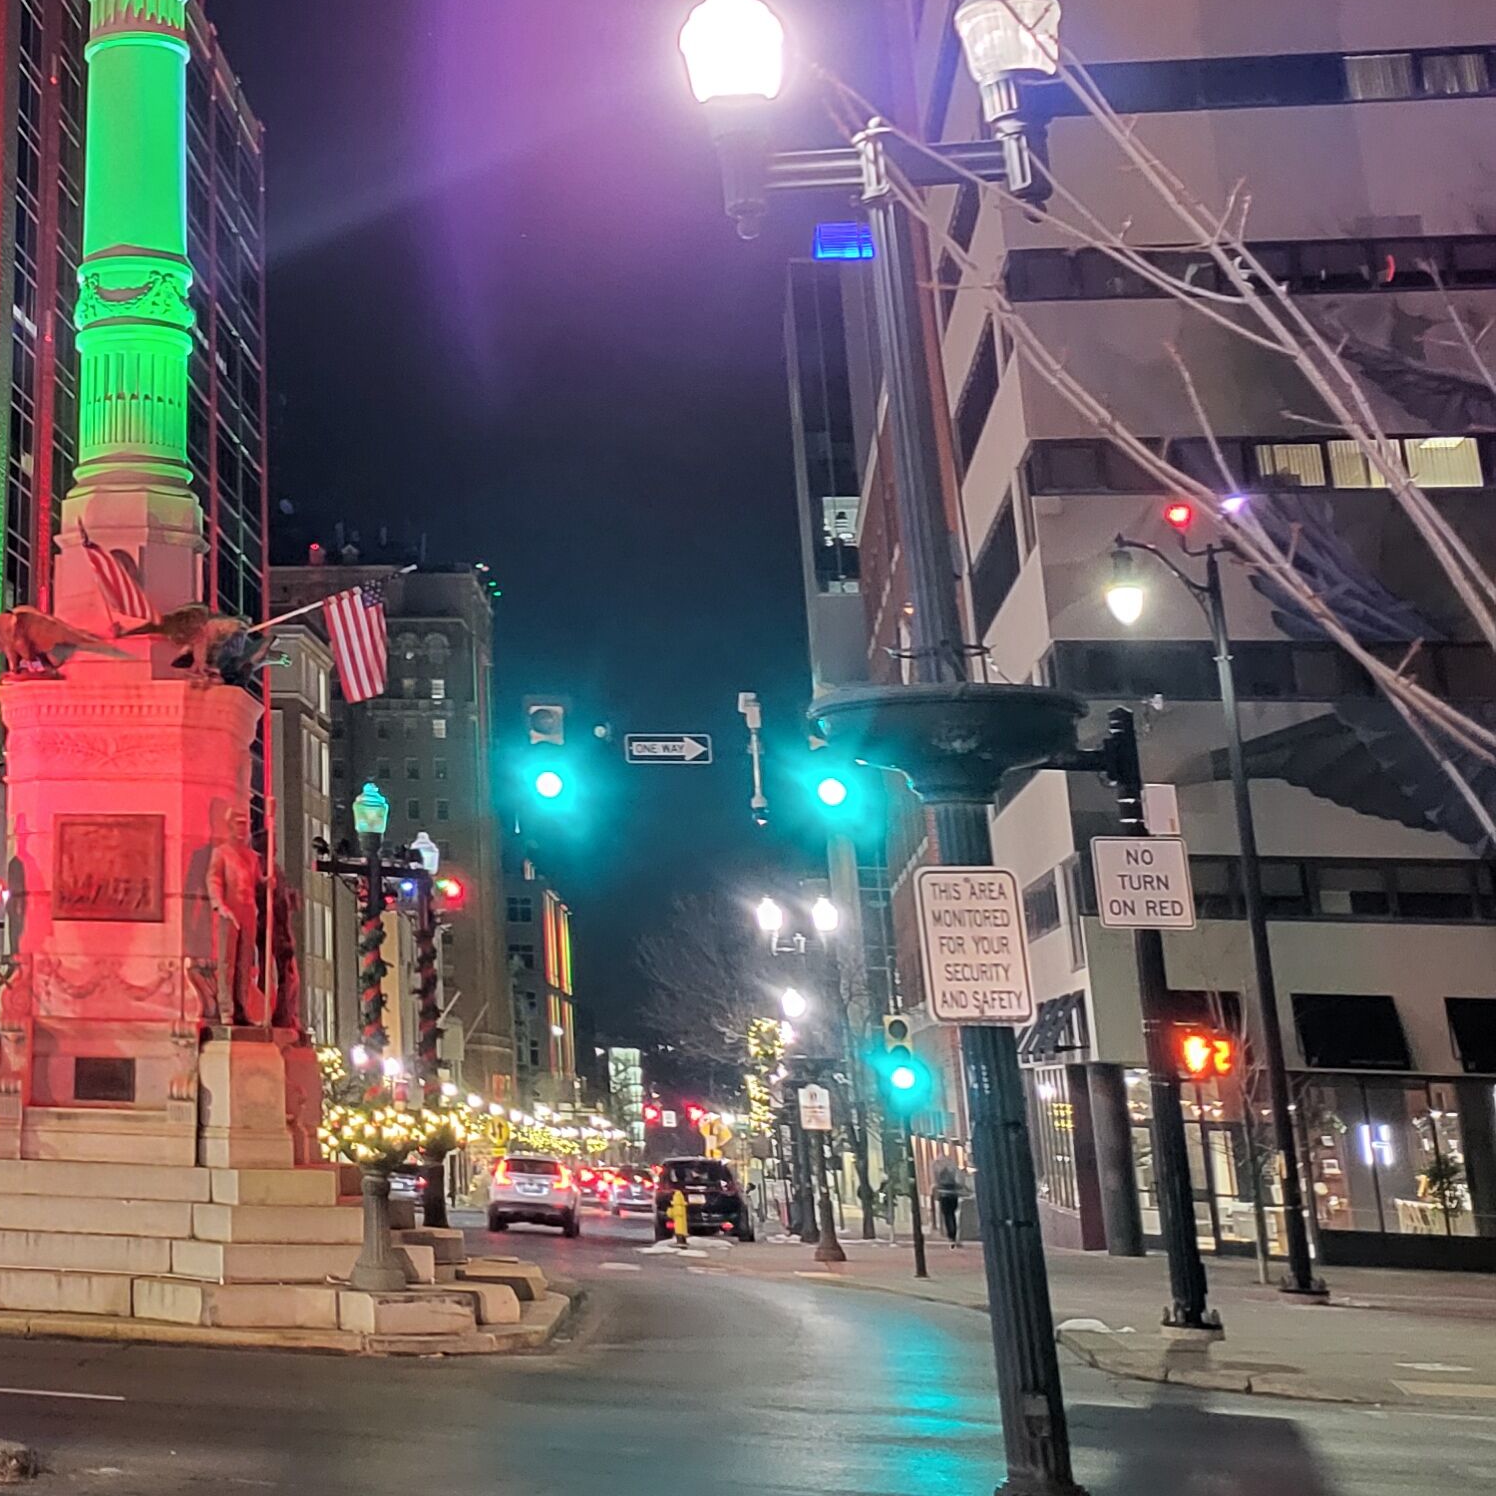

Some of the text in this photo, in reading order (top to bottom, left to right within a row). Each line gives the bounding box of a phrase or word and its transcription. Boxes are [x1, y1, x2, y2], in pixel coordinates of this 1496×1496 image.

[636, 743, 684, 754] ONE WAY
[1125, 848, 1154, 866] NO
[929, 882, 1008, 901] THIS AREA
[1116, 874, 1171, 891] TURN
[1109, 899, 1184, 917] ON RED
[931, 909, 1011, 928] MONITORED
[938, 936, 1011, 955] FOR YOUR
[944, 963, 1012, 982] SECURITY
[940, 990, 1023, 1010] AND SAFETY
